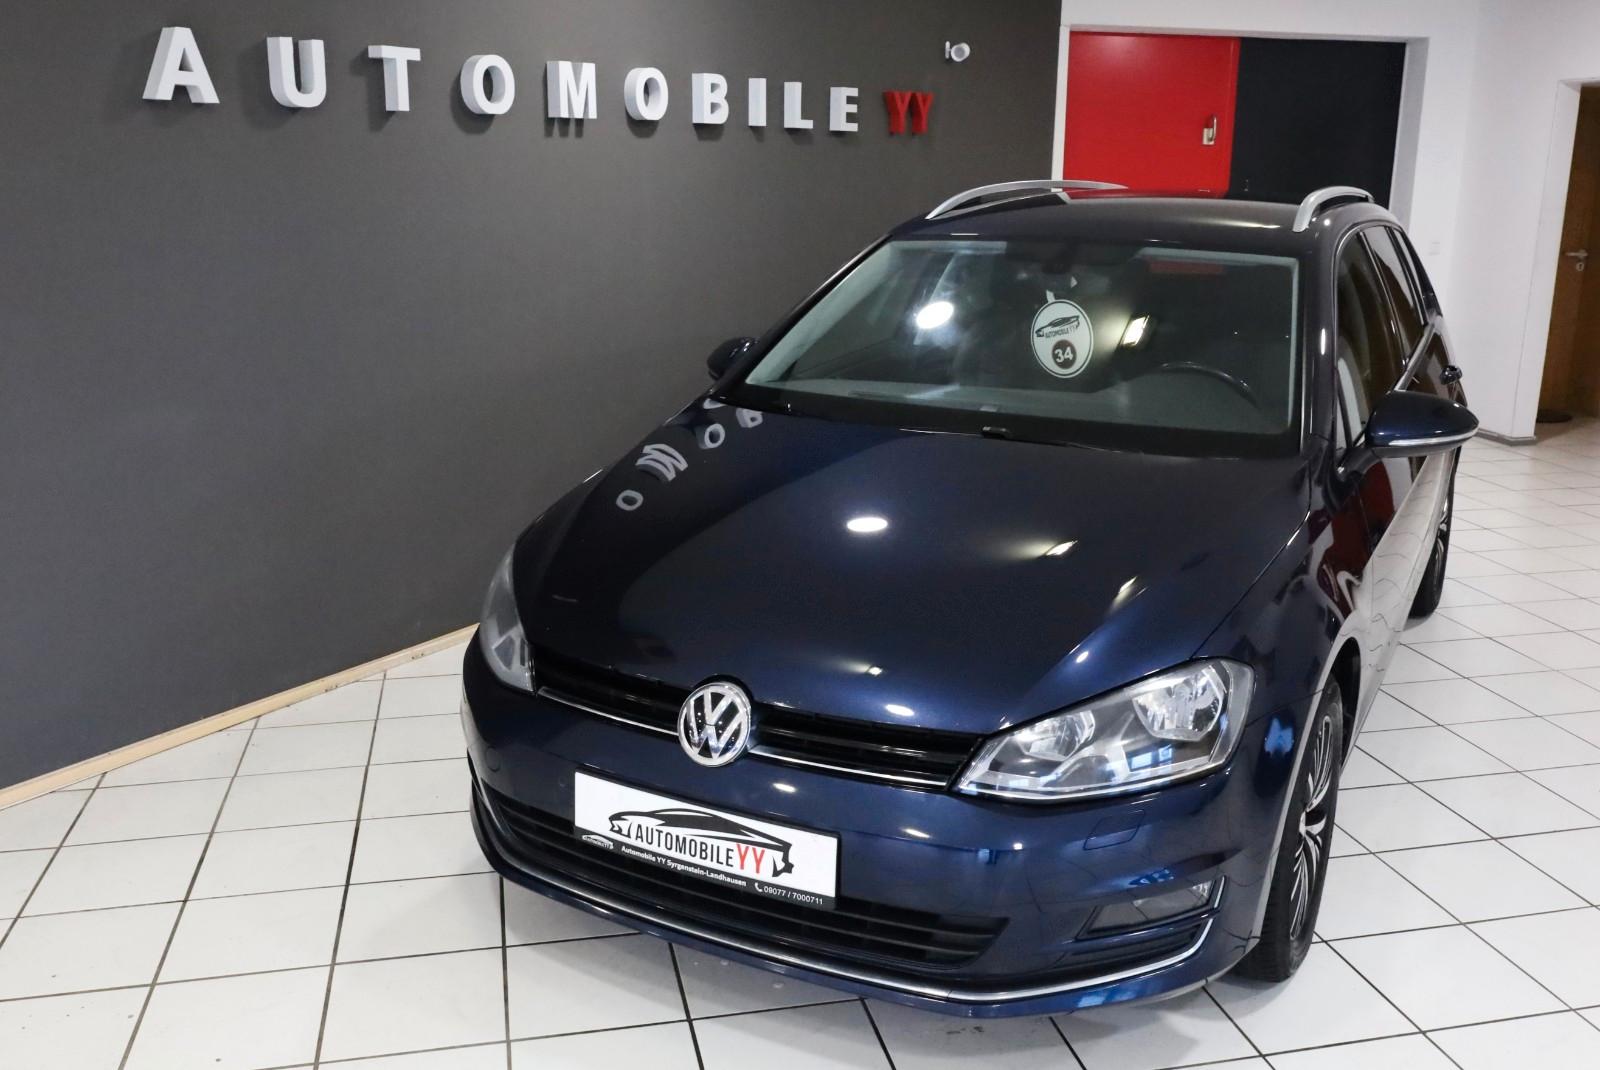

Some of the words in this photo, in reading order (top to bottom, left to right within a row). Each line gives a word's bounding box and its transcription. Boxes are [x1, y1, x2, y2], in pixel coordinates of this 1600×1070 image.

[143, 27, 858, 131] AUTOMOBILE
[883, 90, 934, 134] YY
[1055, 346, 1073, 362] 34
[621, 846, 656, 861] Automobile
[657, 857, 666, 866] YY
[792, 892, 822, 904] 7000711
